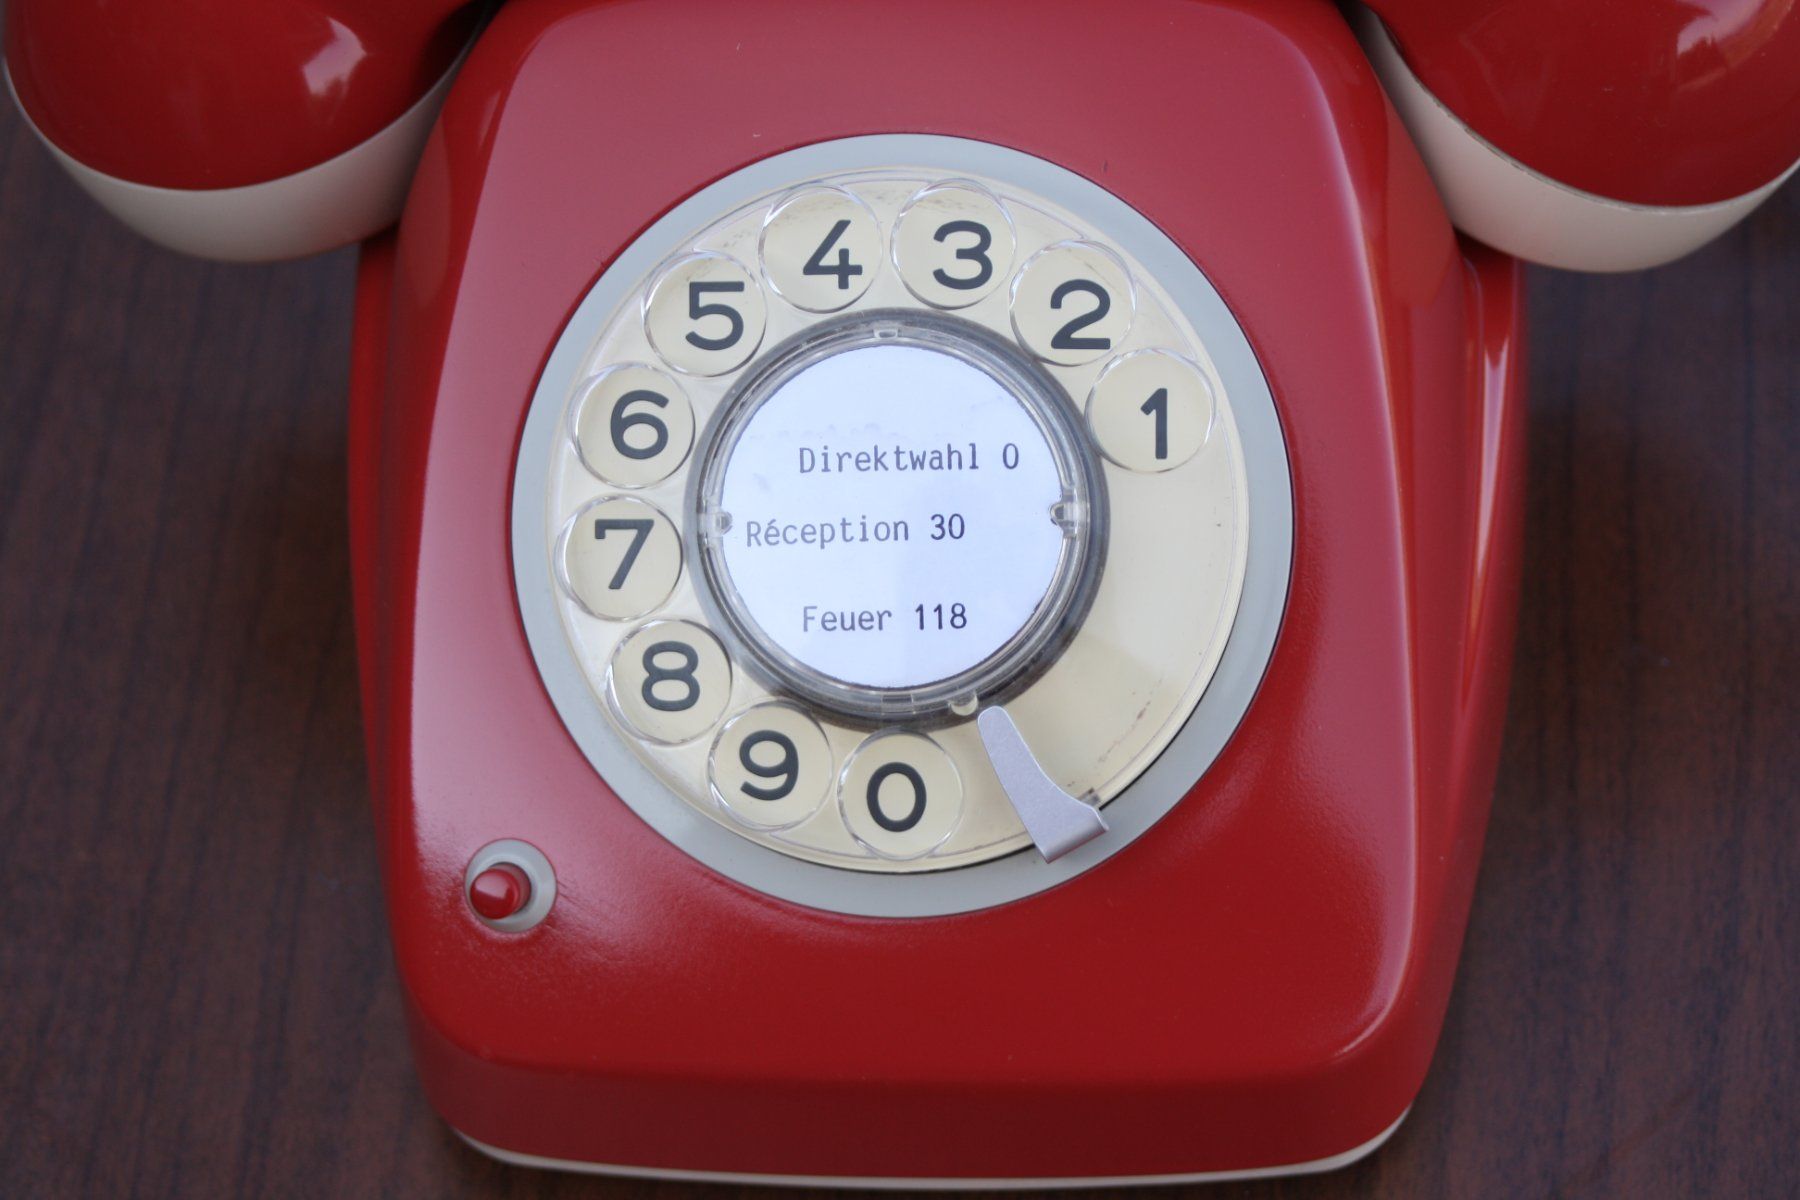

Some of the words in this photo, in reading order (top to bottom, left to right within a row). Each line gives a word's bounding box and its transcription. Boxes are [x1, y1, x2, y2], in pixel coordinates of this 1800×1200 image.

[803, 220, 863, 290] 4
[933, 221, 992, 290] 3
[686, 282, 745, 351] 5
[1051, 279, 1110, 349] 2
[611, 390, 669, 459] 6
[799, 442, 979, 473] Direktwahl
[1141, 388, 1167, 459] 1
[595, 519, 655, 589] 7
[746, 515, 909, 549] Réception
[930, 513, 965, 541] 30
[803, 606, 892, 632] Feuer
[915, 602, 968, 631] 118
[642, 641, 700, 711] 8
[740, 731, 798, 801] 9
[867, 762, 926, 832] 0
